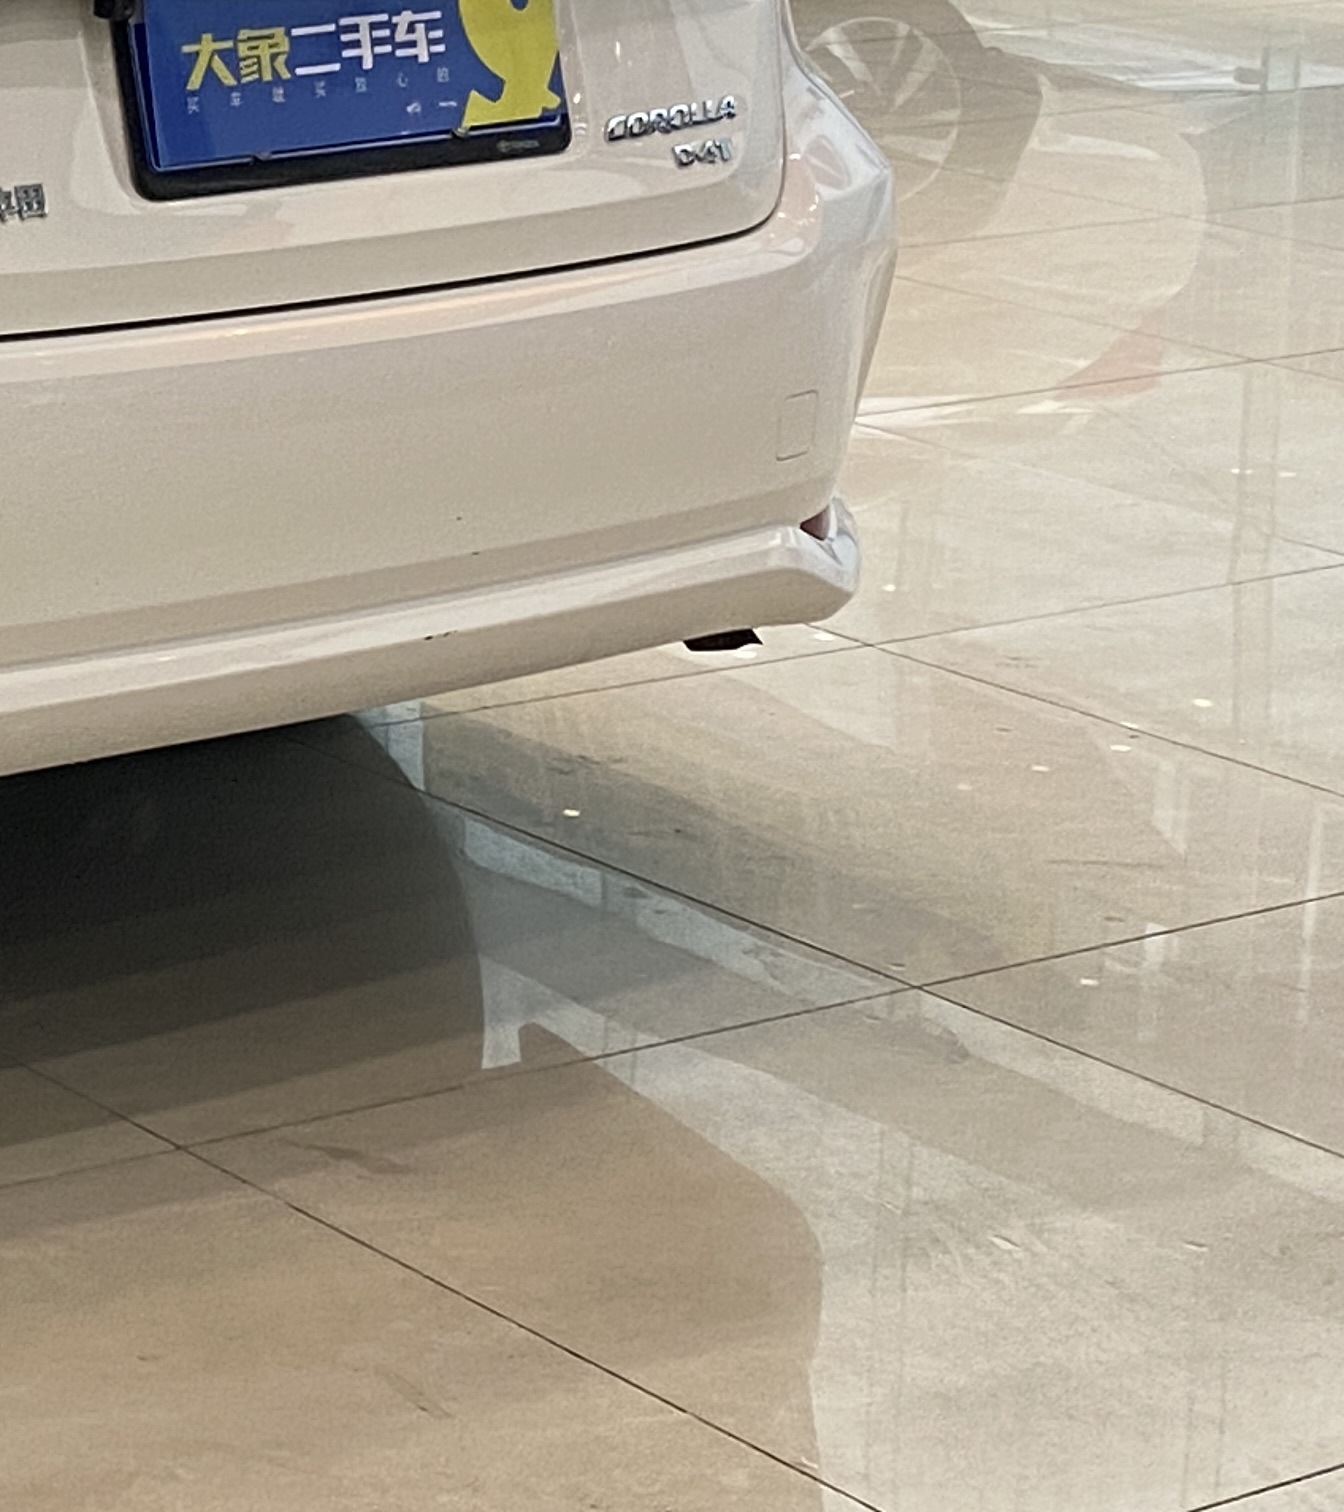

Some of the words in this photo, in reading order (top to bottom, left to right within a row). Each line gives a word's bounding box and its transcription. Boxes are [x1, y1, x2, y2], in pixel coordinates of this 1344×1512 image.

[181, 10, 447, 92] 大象二手车
[605, 94, 737, 142] COROLLA
